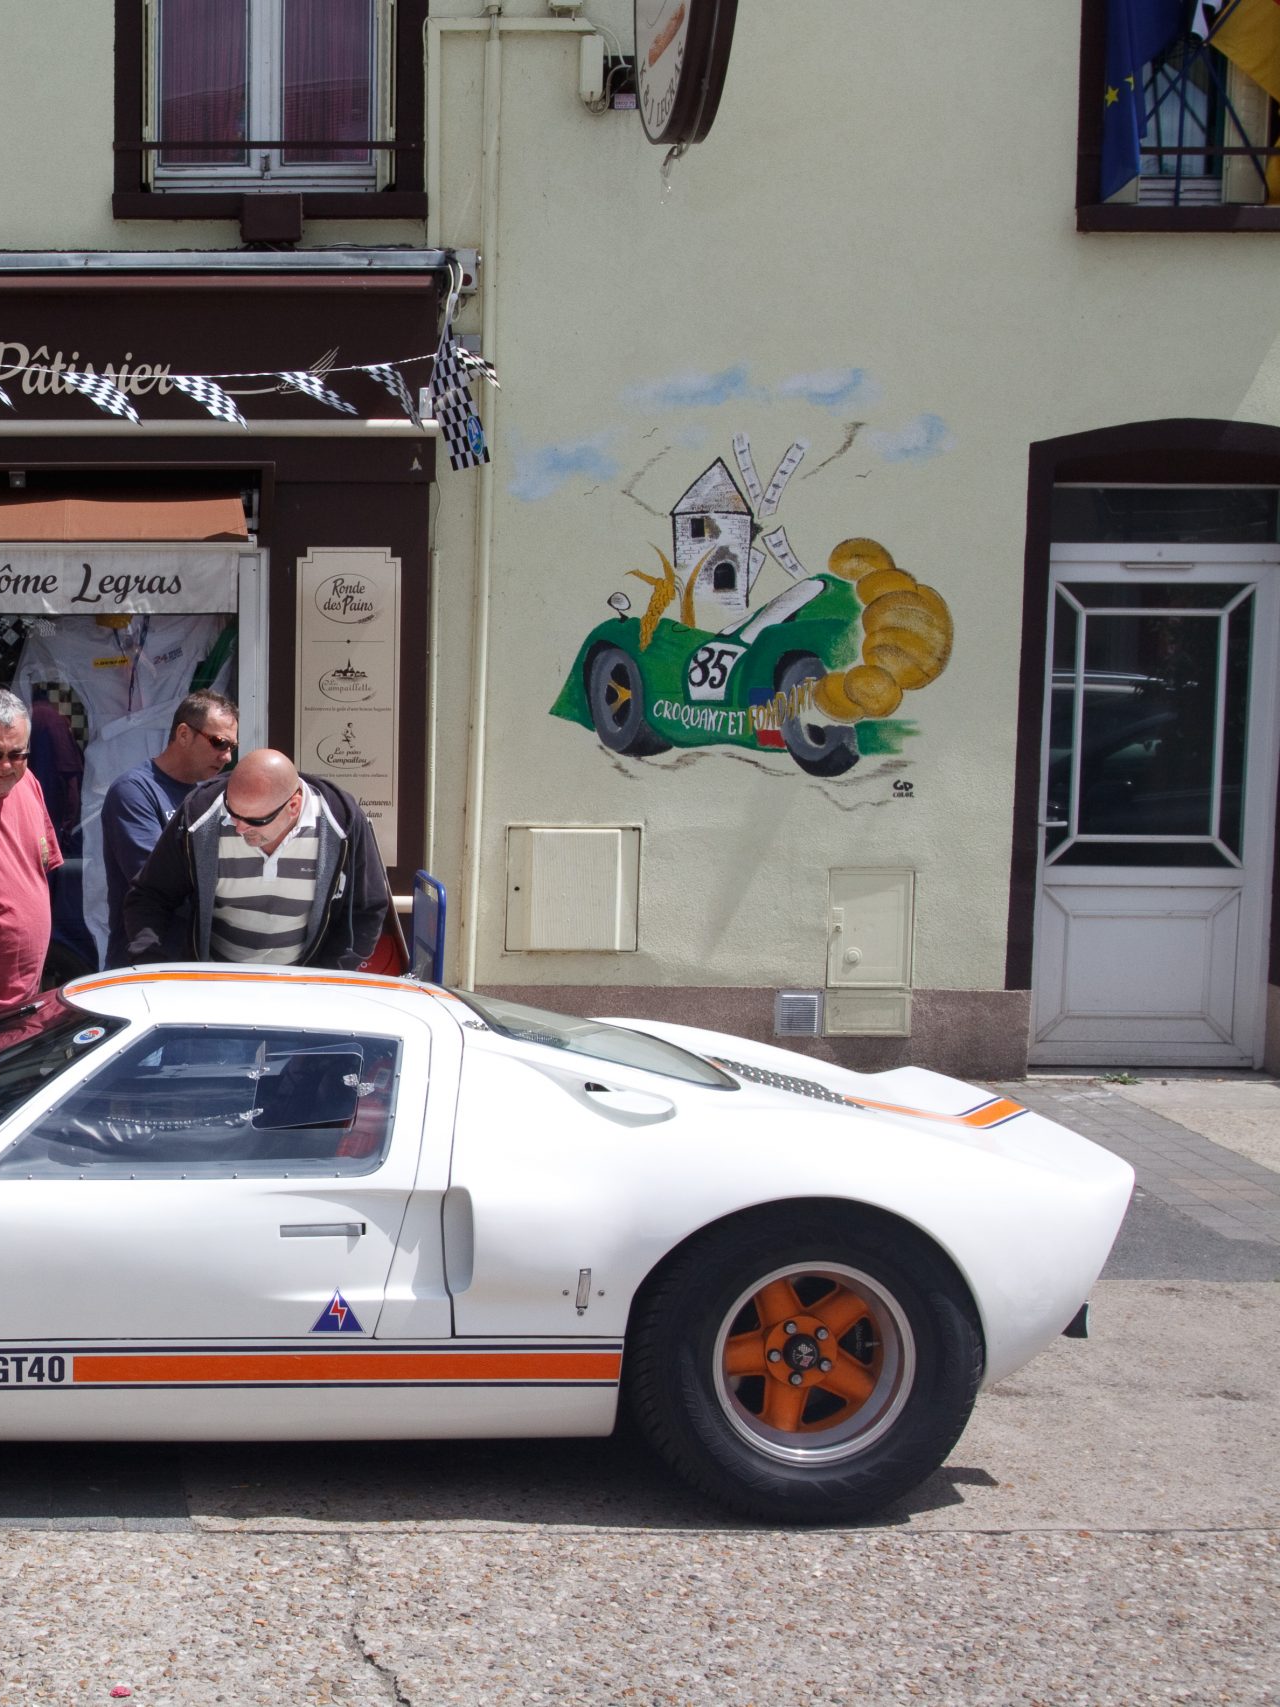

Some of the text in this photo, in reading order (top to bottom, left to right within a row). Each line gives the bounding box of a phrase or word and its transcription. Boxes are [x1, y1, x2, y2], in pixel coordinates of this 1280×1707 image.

[72, 563, 182, 604] Legras
[332, 578, 365, 598] Ronde
[323, 595, 373, 615] des Pains
[688, 647, 738, 690] 85
[653, 699, 727, 732] CROQUANT
[728, 711, 746, 735] ET
[326, 753, 367, 765] Campaillou
[333, 746, 345, 755] Les
[366, 810, 383, 818] dans
